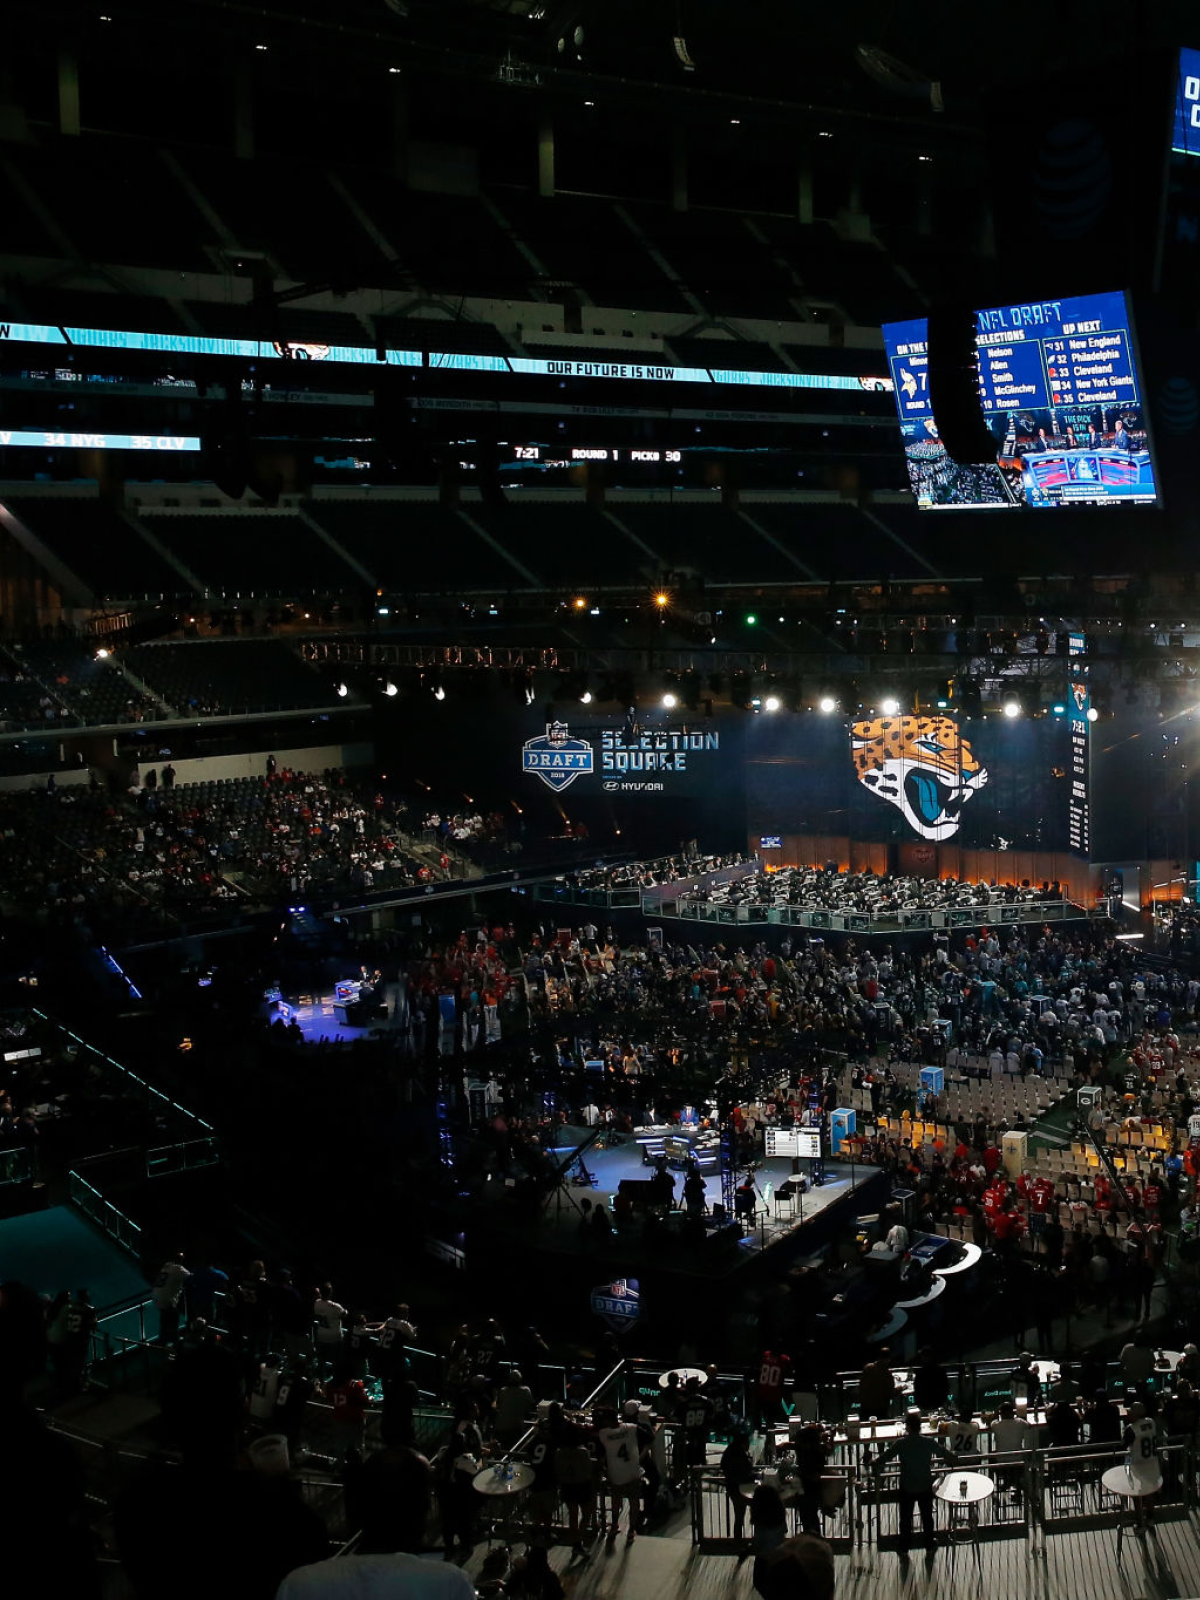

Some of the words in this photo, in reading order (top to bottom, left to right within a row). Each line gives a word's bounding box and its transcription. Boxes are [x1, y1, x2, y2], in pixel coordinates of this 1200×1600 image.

[978, 310, 1009, 331] NFL
[1010, 301, 1062, 327] DRAFT
[1062, 323, 1076, 335] UP
[1077, 320, 1101, 333] NEXT
[1069, 338, 1087, 350] New
[1088, 334, 1121, 349] England
[1071, 349, 1120, 363] Philadelphia
[547, 361, 572, 374] OUR
[577, 363, 627, 377] FUTURE
[631, 366, 643, 377] IS
[647, 367, 674, 379] NOW
[1073, 363, 1113, 376] Cleveland
[1077, 390, 1117, 403] Cleveland
[45, 433, 66, 446] 34
[130, 436, 154, 449] 35
[572, 448, 607, 460] ROUND
[612, 449, 619, 461] 1
[665, 450, 682, 462] 30
[528, 753, 587, 766] DRAFT
[759, 1363, 782, 1387] 80
[955, 1433, 973, 1451] 26
[617, 1443, 630, 1463] 4
